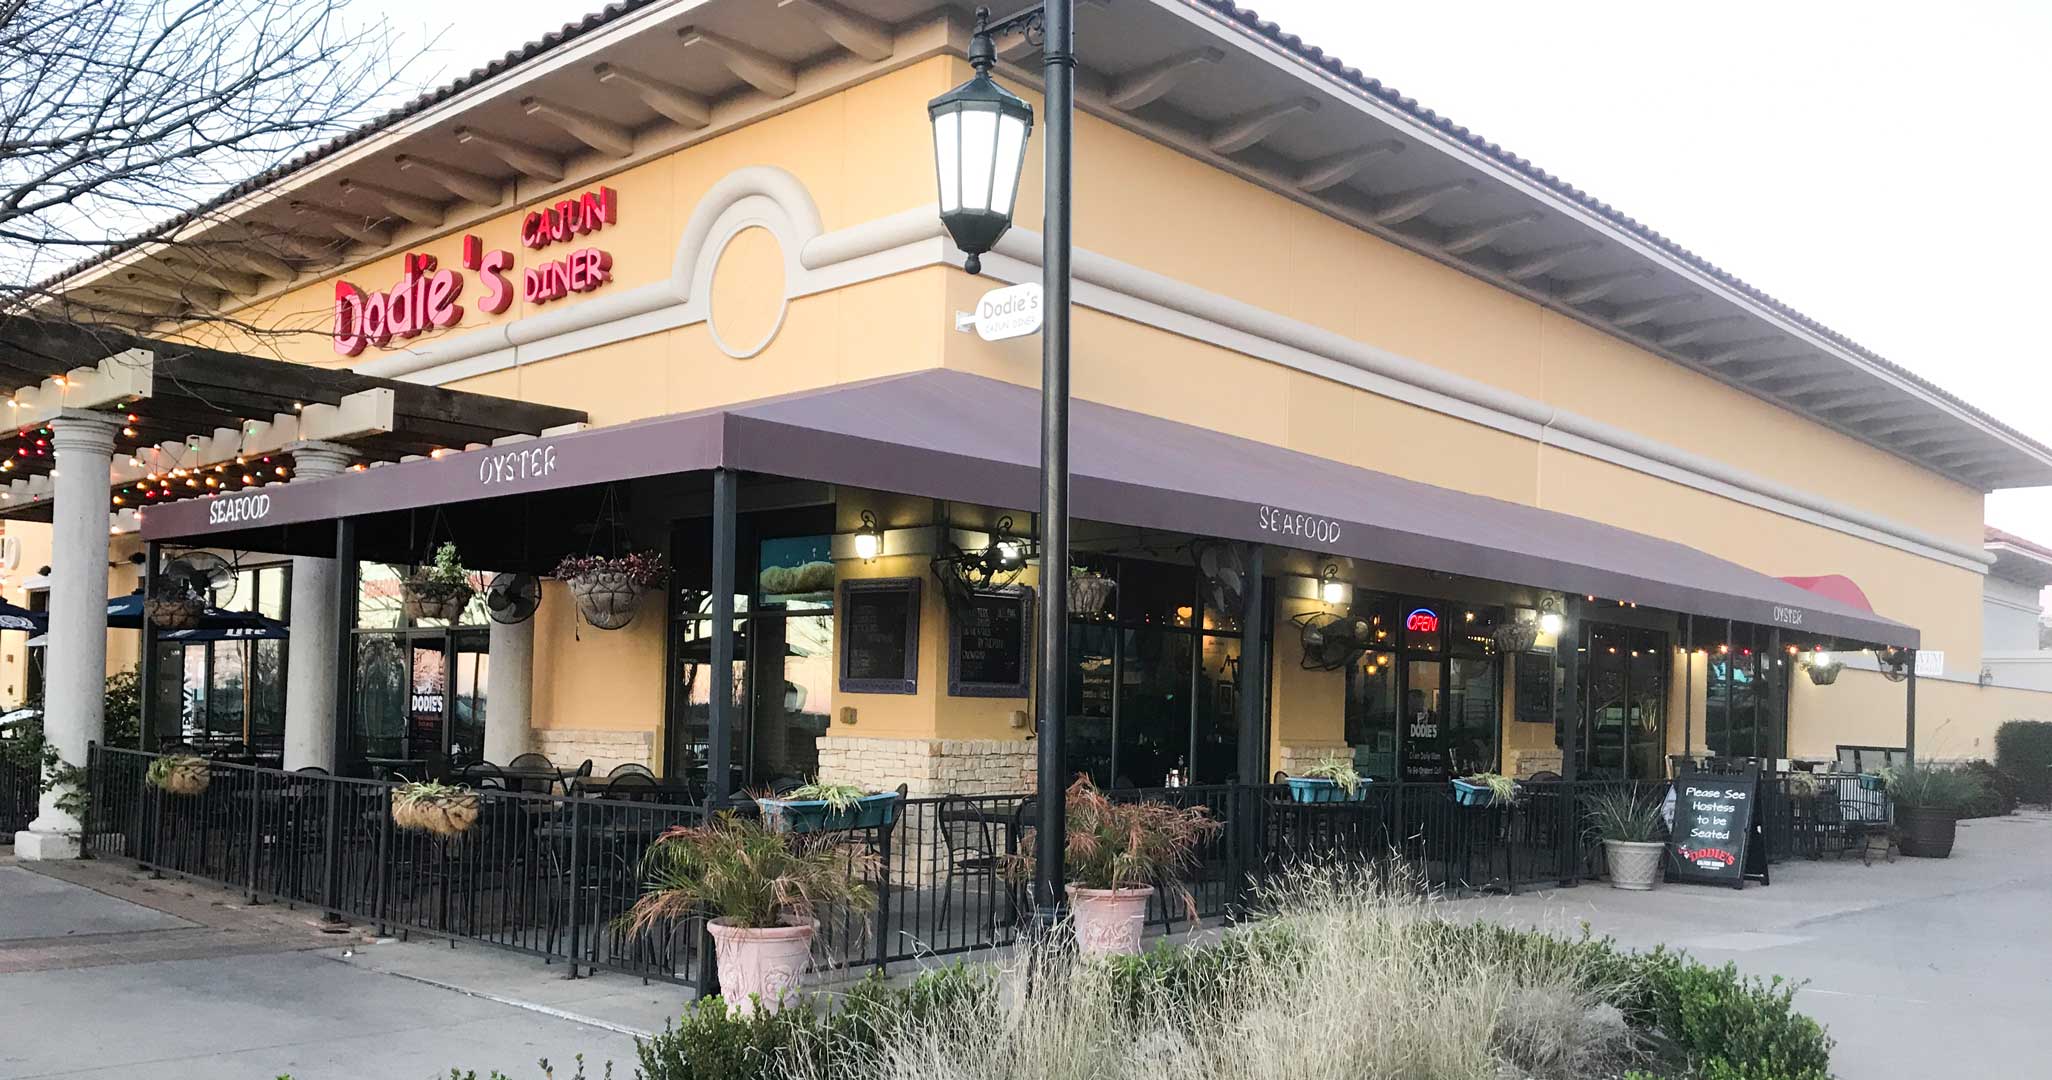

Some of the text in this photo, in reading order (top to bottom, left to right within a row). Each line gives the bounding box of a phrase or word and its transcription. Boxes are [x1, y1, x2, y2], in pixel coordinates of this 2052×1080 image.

[521, 186, 617, 249] CAJUN
[523, 247, 613, 305] DINER
[333, 234, 514, 356] Dodie's
[983, 291, 1039, 319] Dodie's
[479, 445, 556, 485] OYSTER
[209, 494, 271, 525] SEAFOOD
[1259, 505, 1341, 543] SEAFOOD
[1408, 614, 1438, 632] OPEN
[1773, 606, 1803, 625] OYSTER
[1686, 787, 1746, 799] Please See
[1693, 801, 1735, 812] Hostess
[1697, 815, 1727, 825] to be
[1690, 828, 1730, 840] Seated
[1690, 847, 1735, 865] DODIE'S
